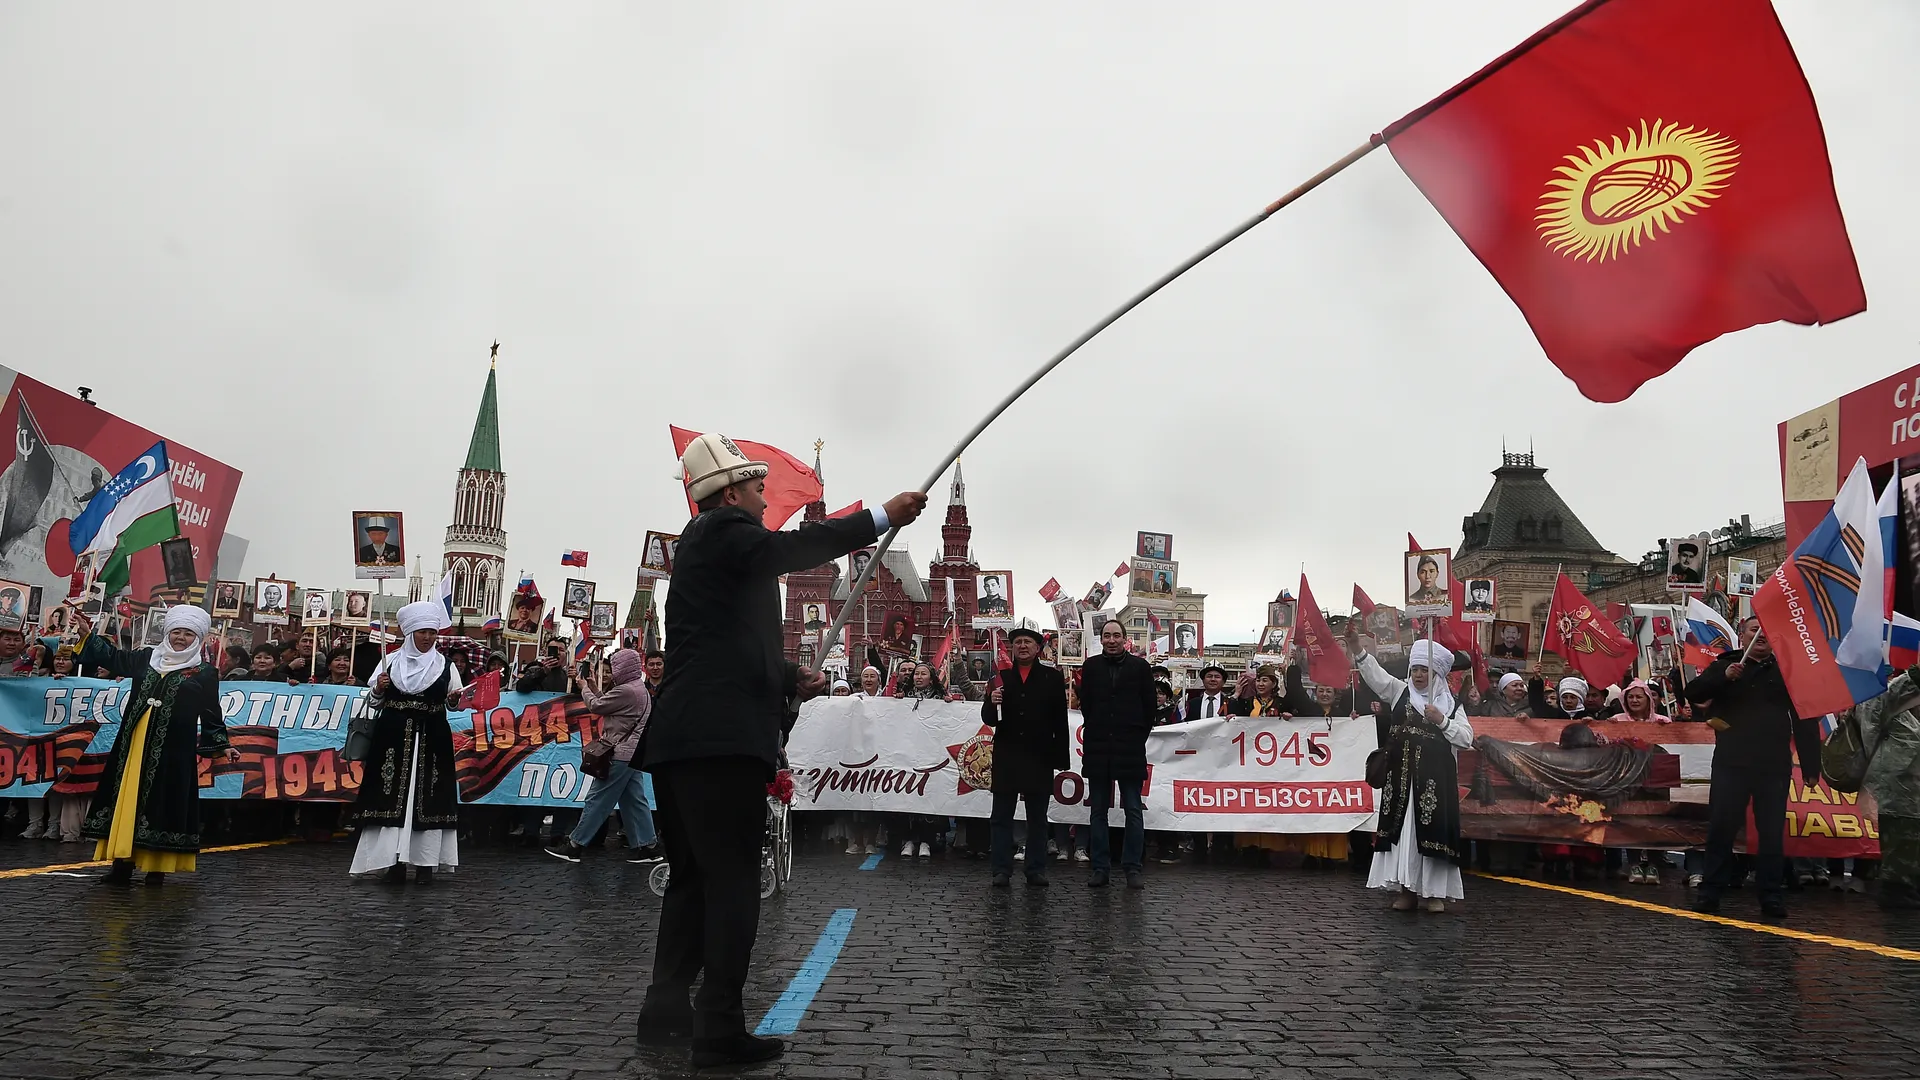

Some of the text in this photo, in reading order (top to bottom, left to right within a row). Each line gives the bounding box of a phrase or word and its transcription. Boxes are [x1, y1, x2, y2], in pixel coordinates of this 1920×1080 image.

[1893, 382, 1908, 408] С
[472, 702, 571, 752] 1944
[1231, 731, 1332, 767] 1945
[1183, 787, 1363, 808] КЫРГЫЗСТАН
